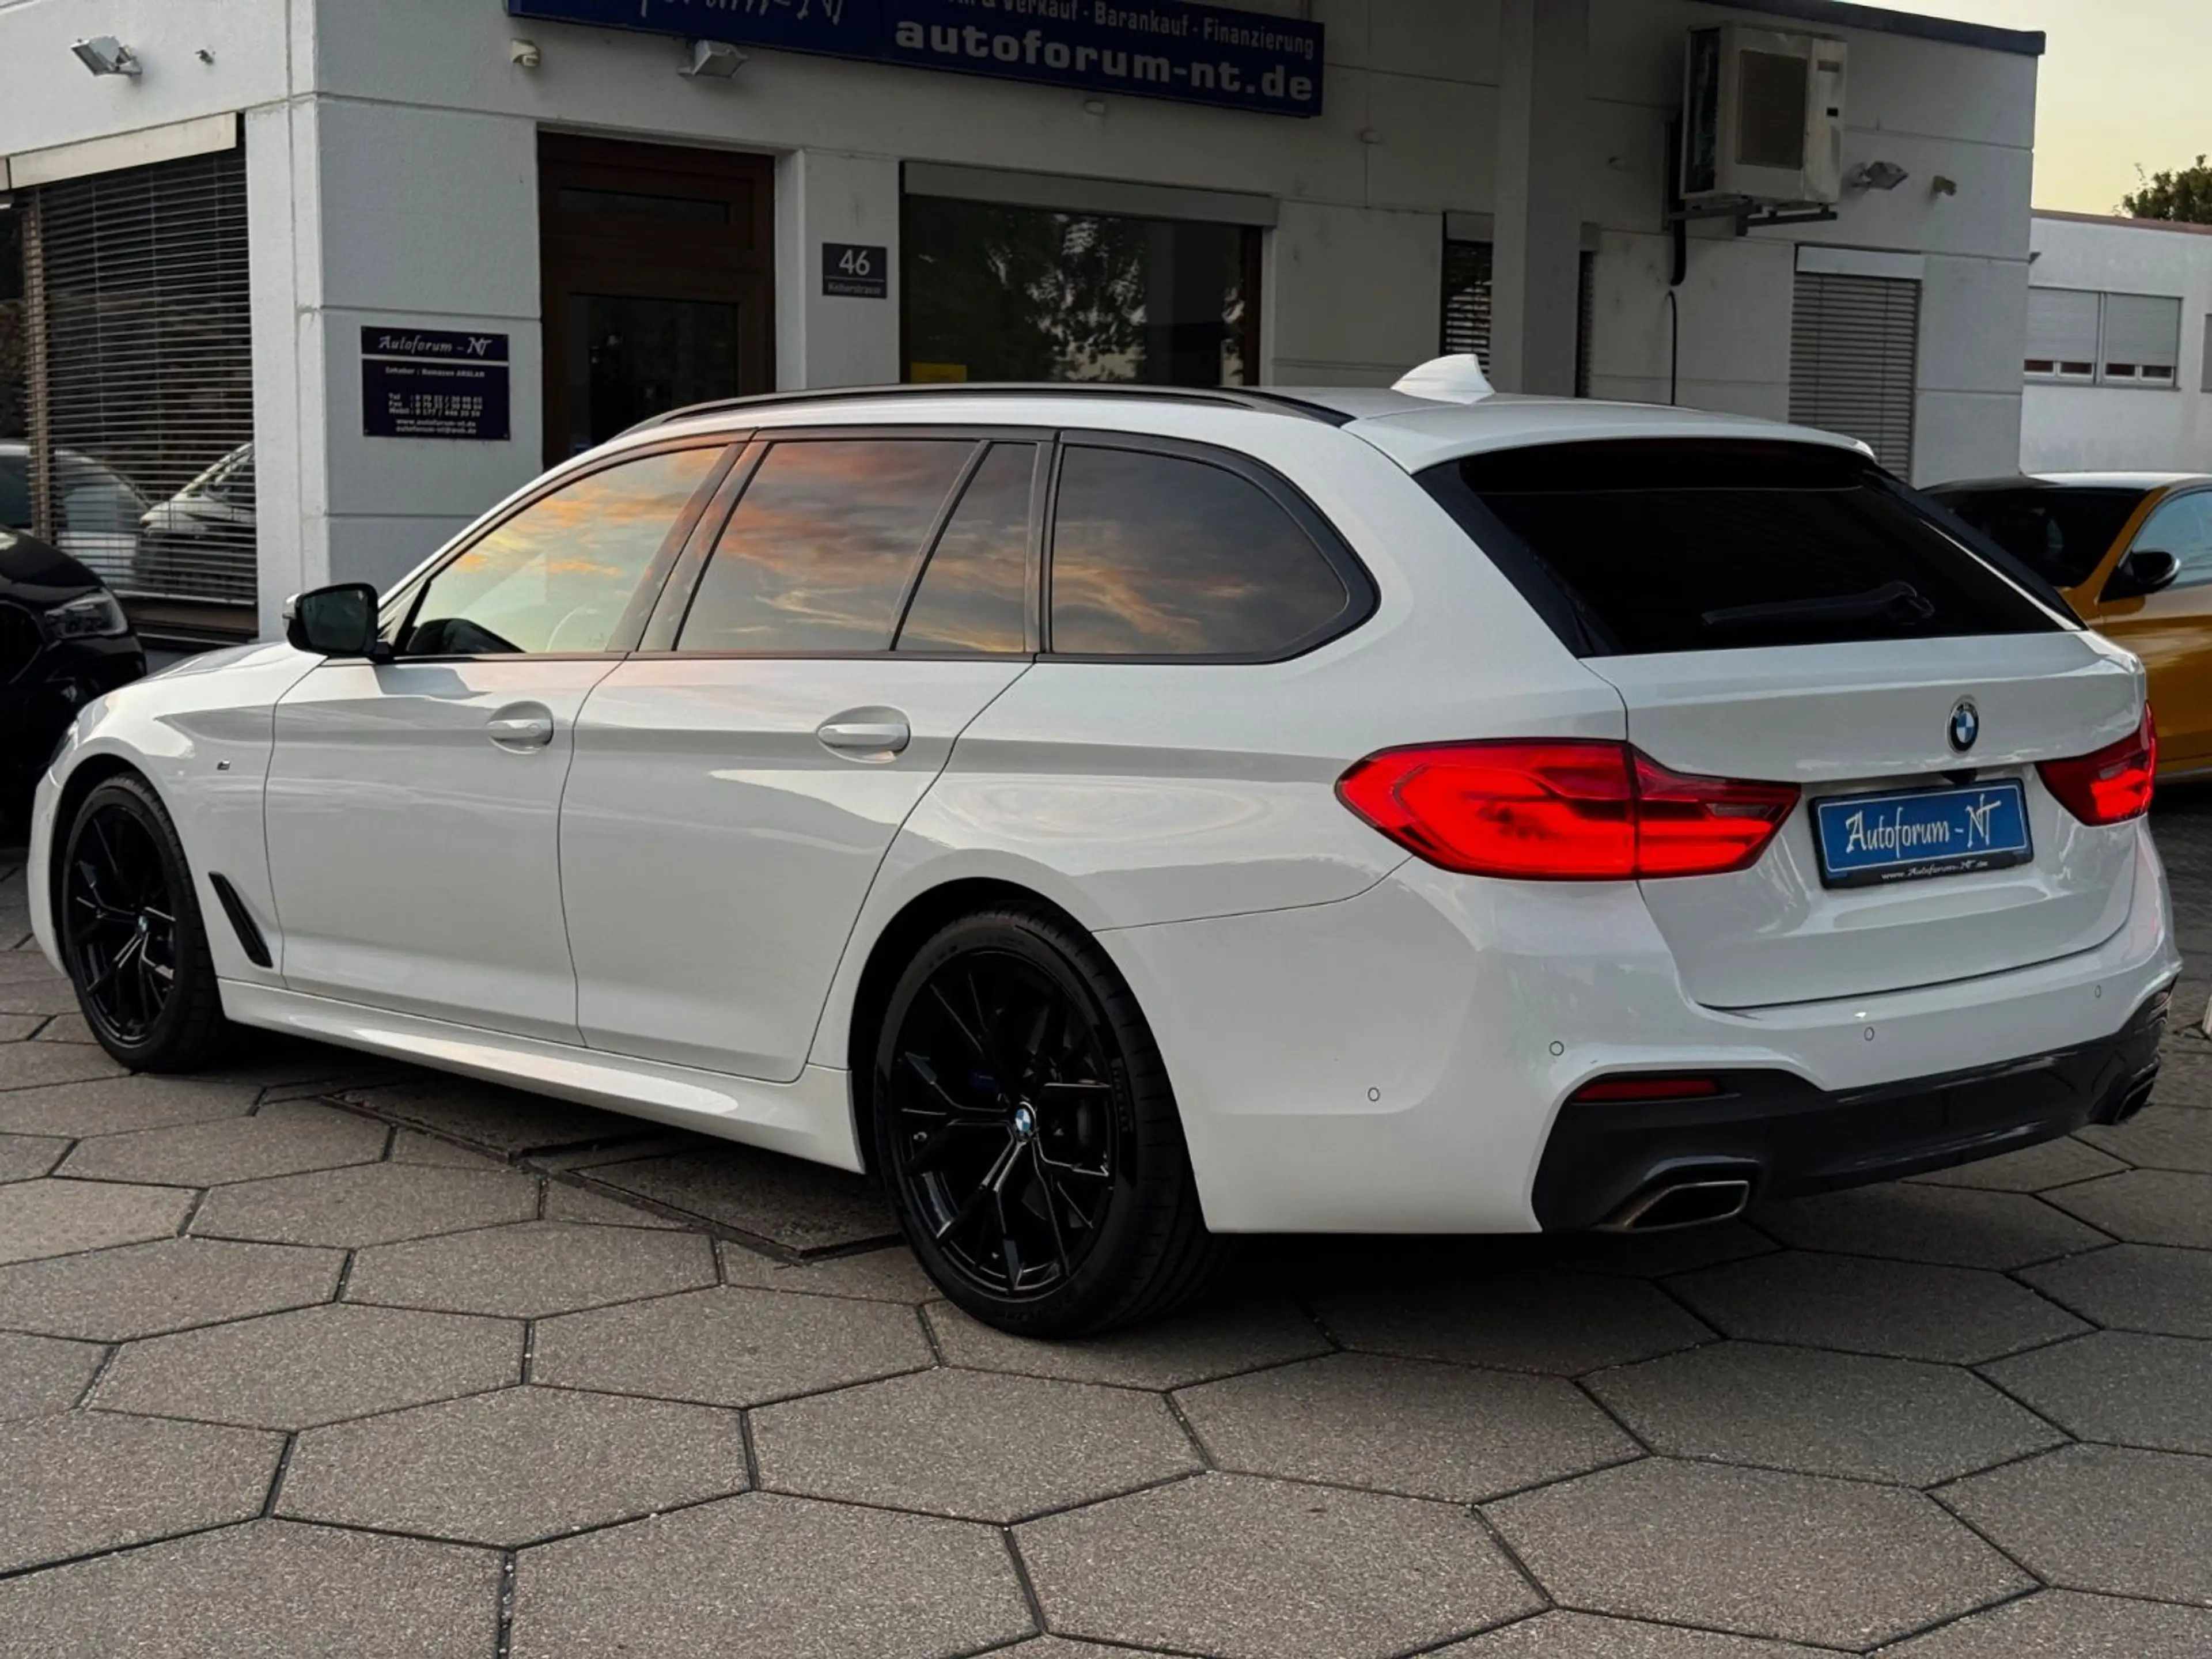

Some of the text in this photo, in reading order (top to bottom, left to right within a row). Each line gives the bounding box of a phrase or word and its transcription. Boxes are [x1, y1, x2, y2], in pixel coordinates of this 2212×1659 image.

[1095, 2, 1189, 36] Barankauf
[1203, 17, 1314, 60] Finanzierung
[895, 21, 1313, 101] autoforum-nt.de
[840, 249, 870, 275] 46
[378, 335, 453, 354] Autoforum
[1845, 807, 1949, 859] Autoforum
